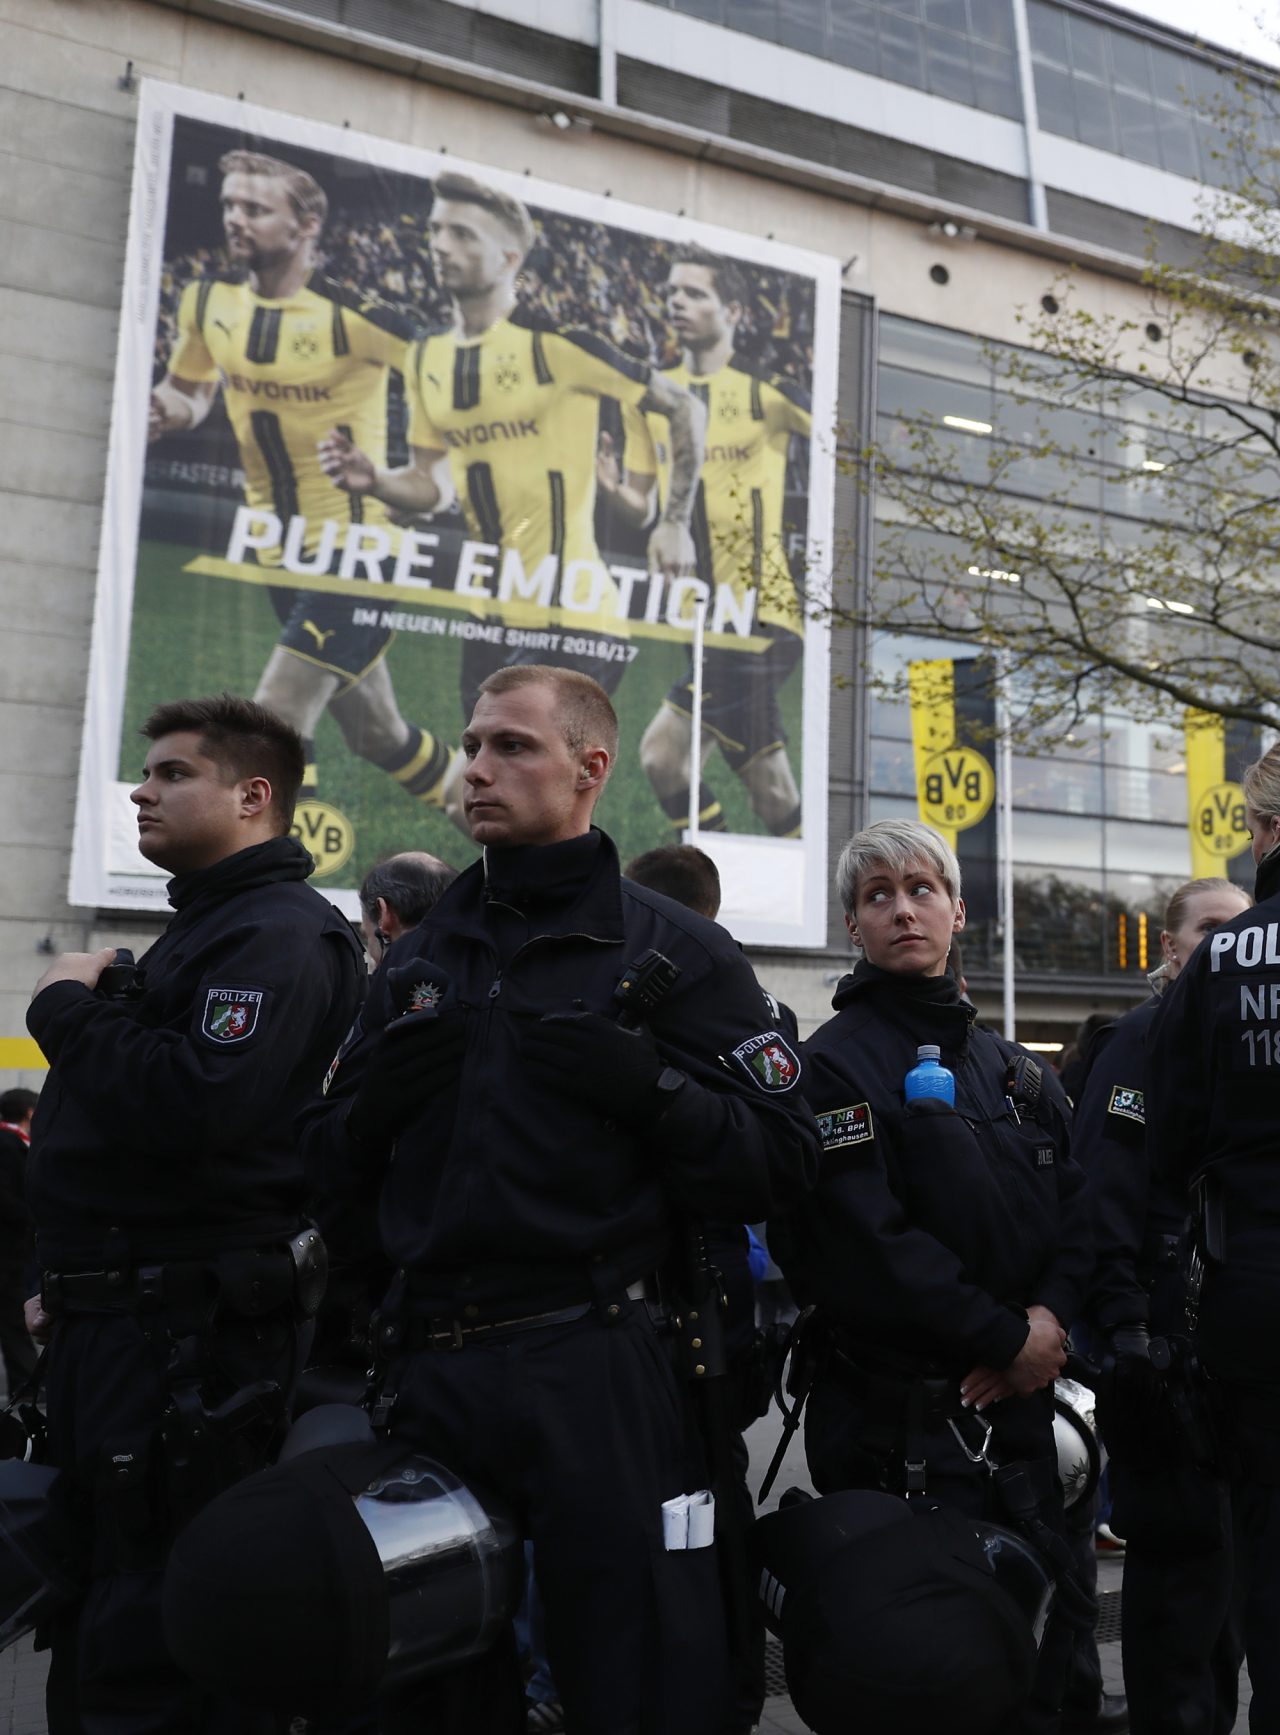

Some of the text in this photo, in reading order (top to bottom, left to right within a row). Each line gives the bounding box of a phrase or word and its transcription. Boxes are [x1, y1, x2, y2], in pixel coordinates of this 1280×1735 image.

[225, 504, 757, 638] PURE EMOTION
[352, 607, 640, 663] IM NEUEN HOME SHIRT 2016/17
[209, 991, 260, 1003] POLIZEI
[836, 1108, 865, 1122] NRW
[847, 1121, 865, 1132] BPH
[823, 1131, 869, 1147] cklinghausen
